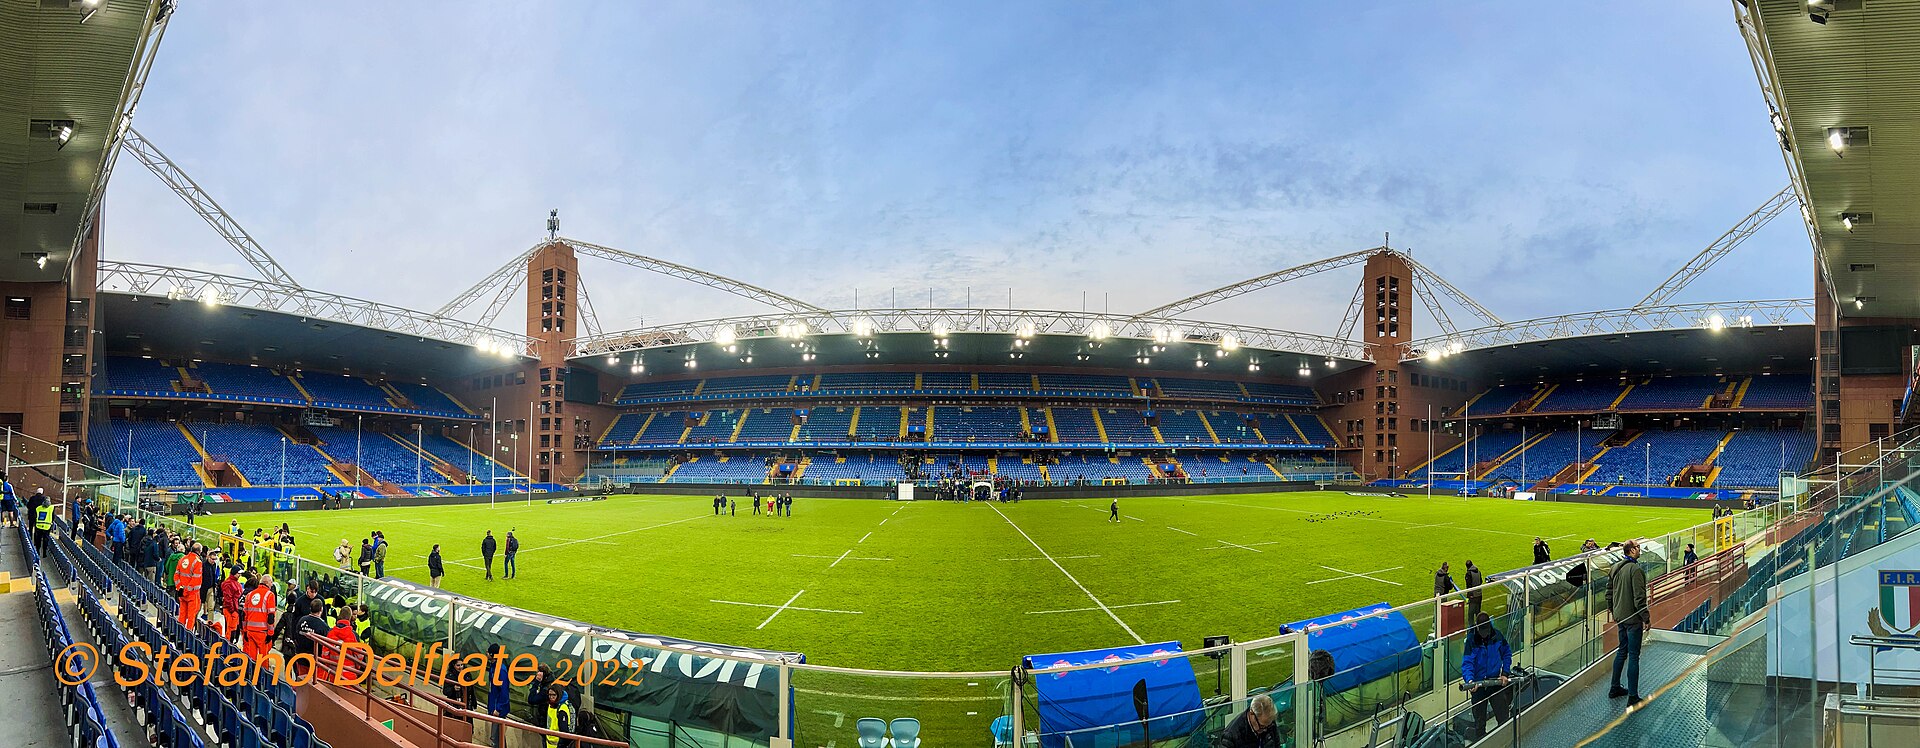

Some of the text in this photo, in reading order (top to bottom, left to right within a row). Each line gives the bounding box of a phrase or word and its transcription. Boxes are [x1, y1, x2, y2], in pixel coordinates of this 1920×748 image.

[1883, 573, 1920, 584] F.I.R.
[370, 579, 766, 688] macron macron
